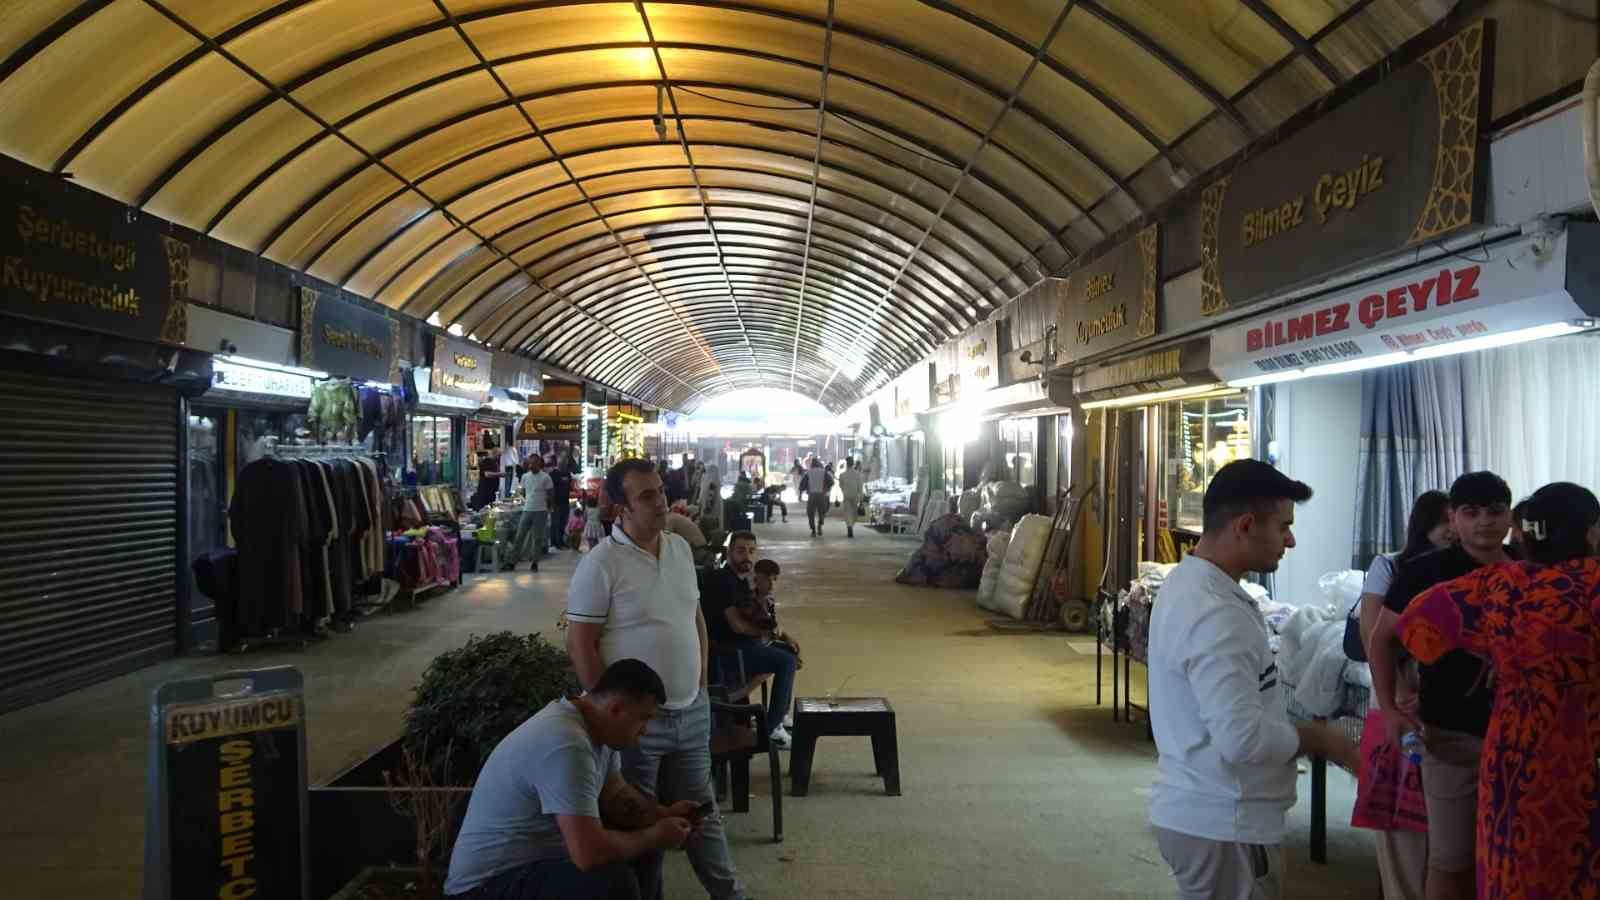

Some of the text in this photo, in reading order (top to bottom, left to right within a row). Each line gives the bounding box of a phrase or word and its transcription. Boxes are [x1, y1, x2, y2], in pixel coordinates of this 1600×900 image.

[1243, 154, 1384, 246] Bilmez Çeyiz
[1247, 265, 1480, 352] BİLMEZ ÇEYİZ
[171, 697, 292, 739] KUYUMCU
